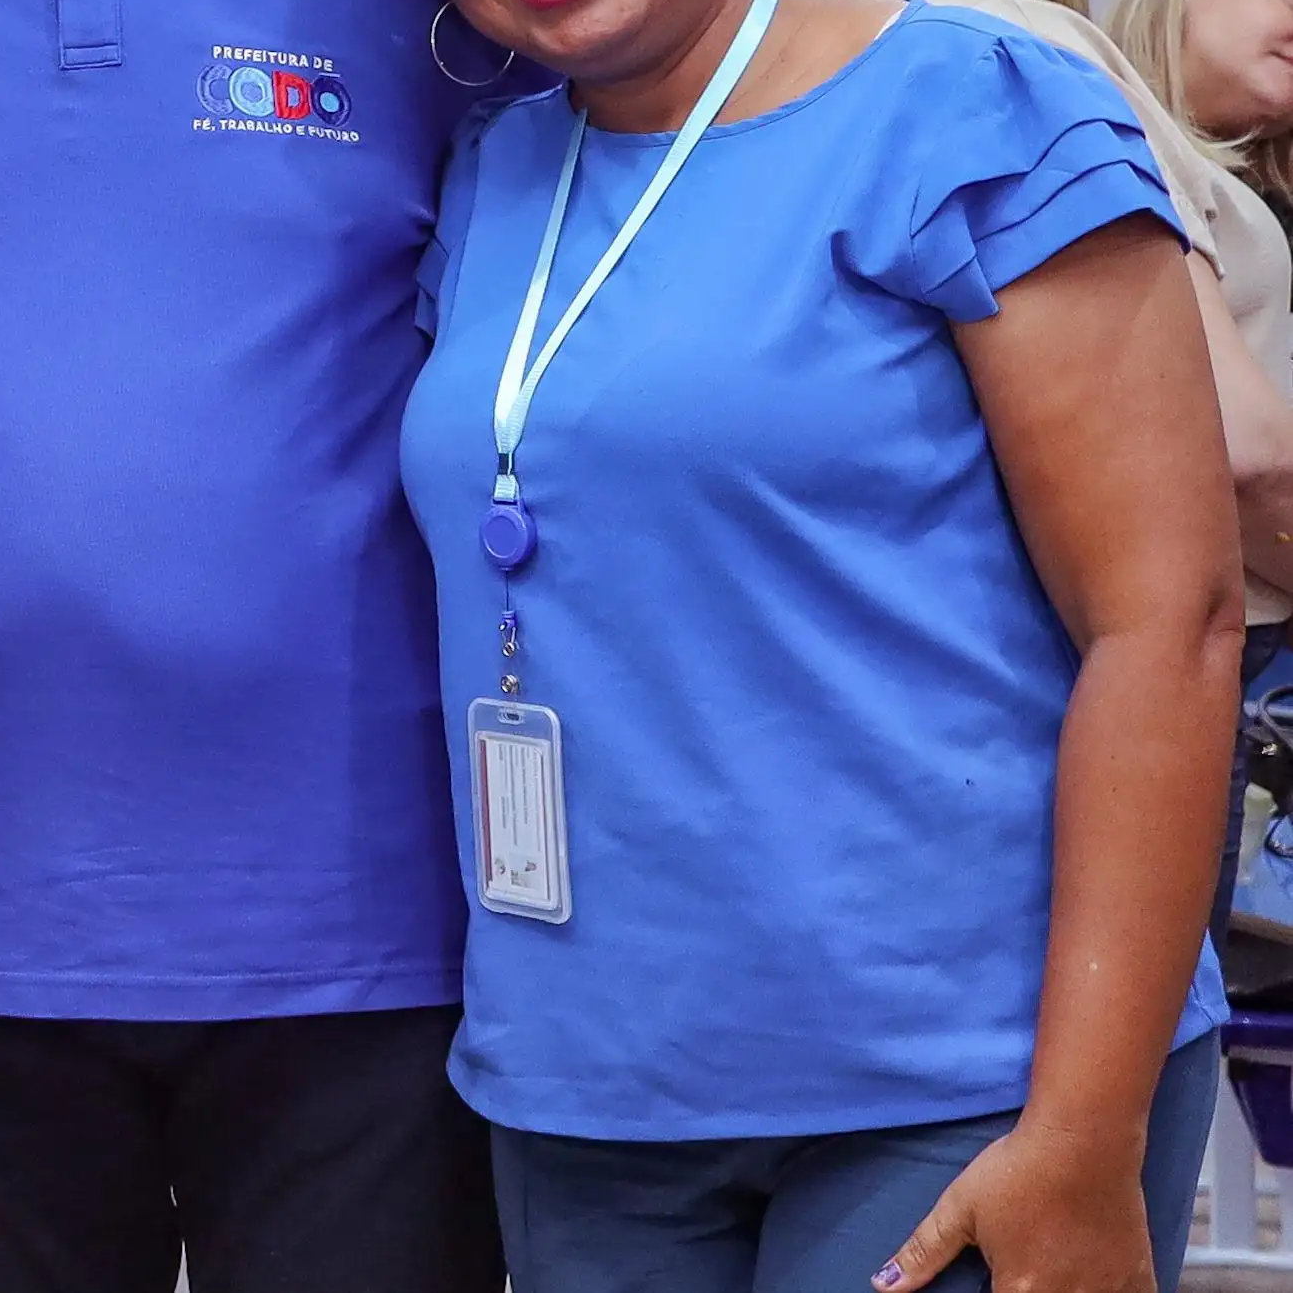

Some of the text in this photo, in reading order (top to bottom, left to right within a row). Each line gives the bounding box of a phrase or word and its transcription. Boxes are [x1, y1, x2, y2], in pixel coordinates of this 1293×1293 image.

[212, 45, 333, 72] PREFEITURA DE
[218, 119, 293, 135] TRABALHO
[295, 124, 306, 136] E
[307, 125, 360, 143] FUTURO
